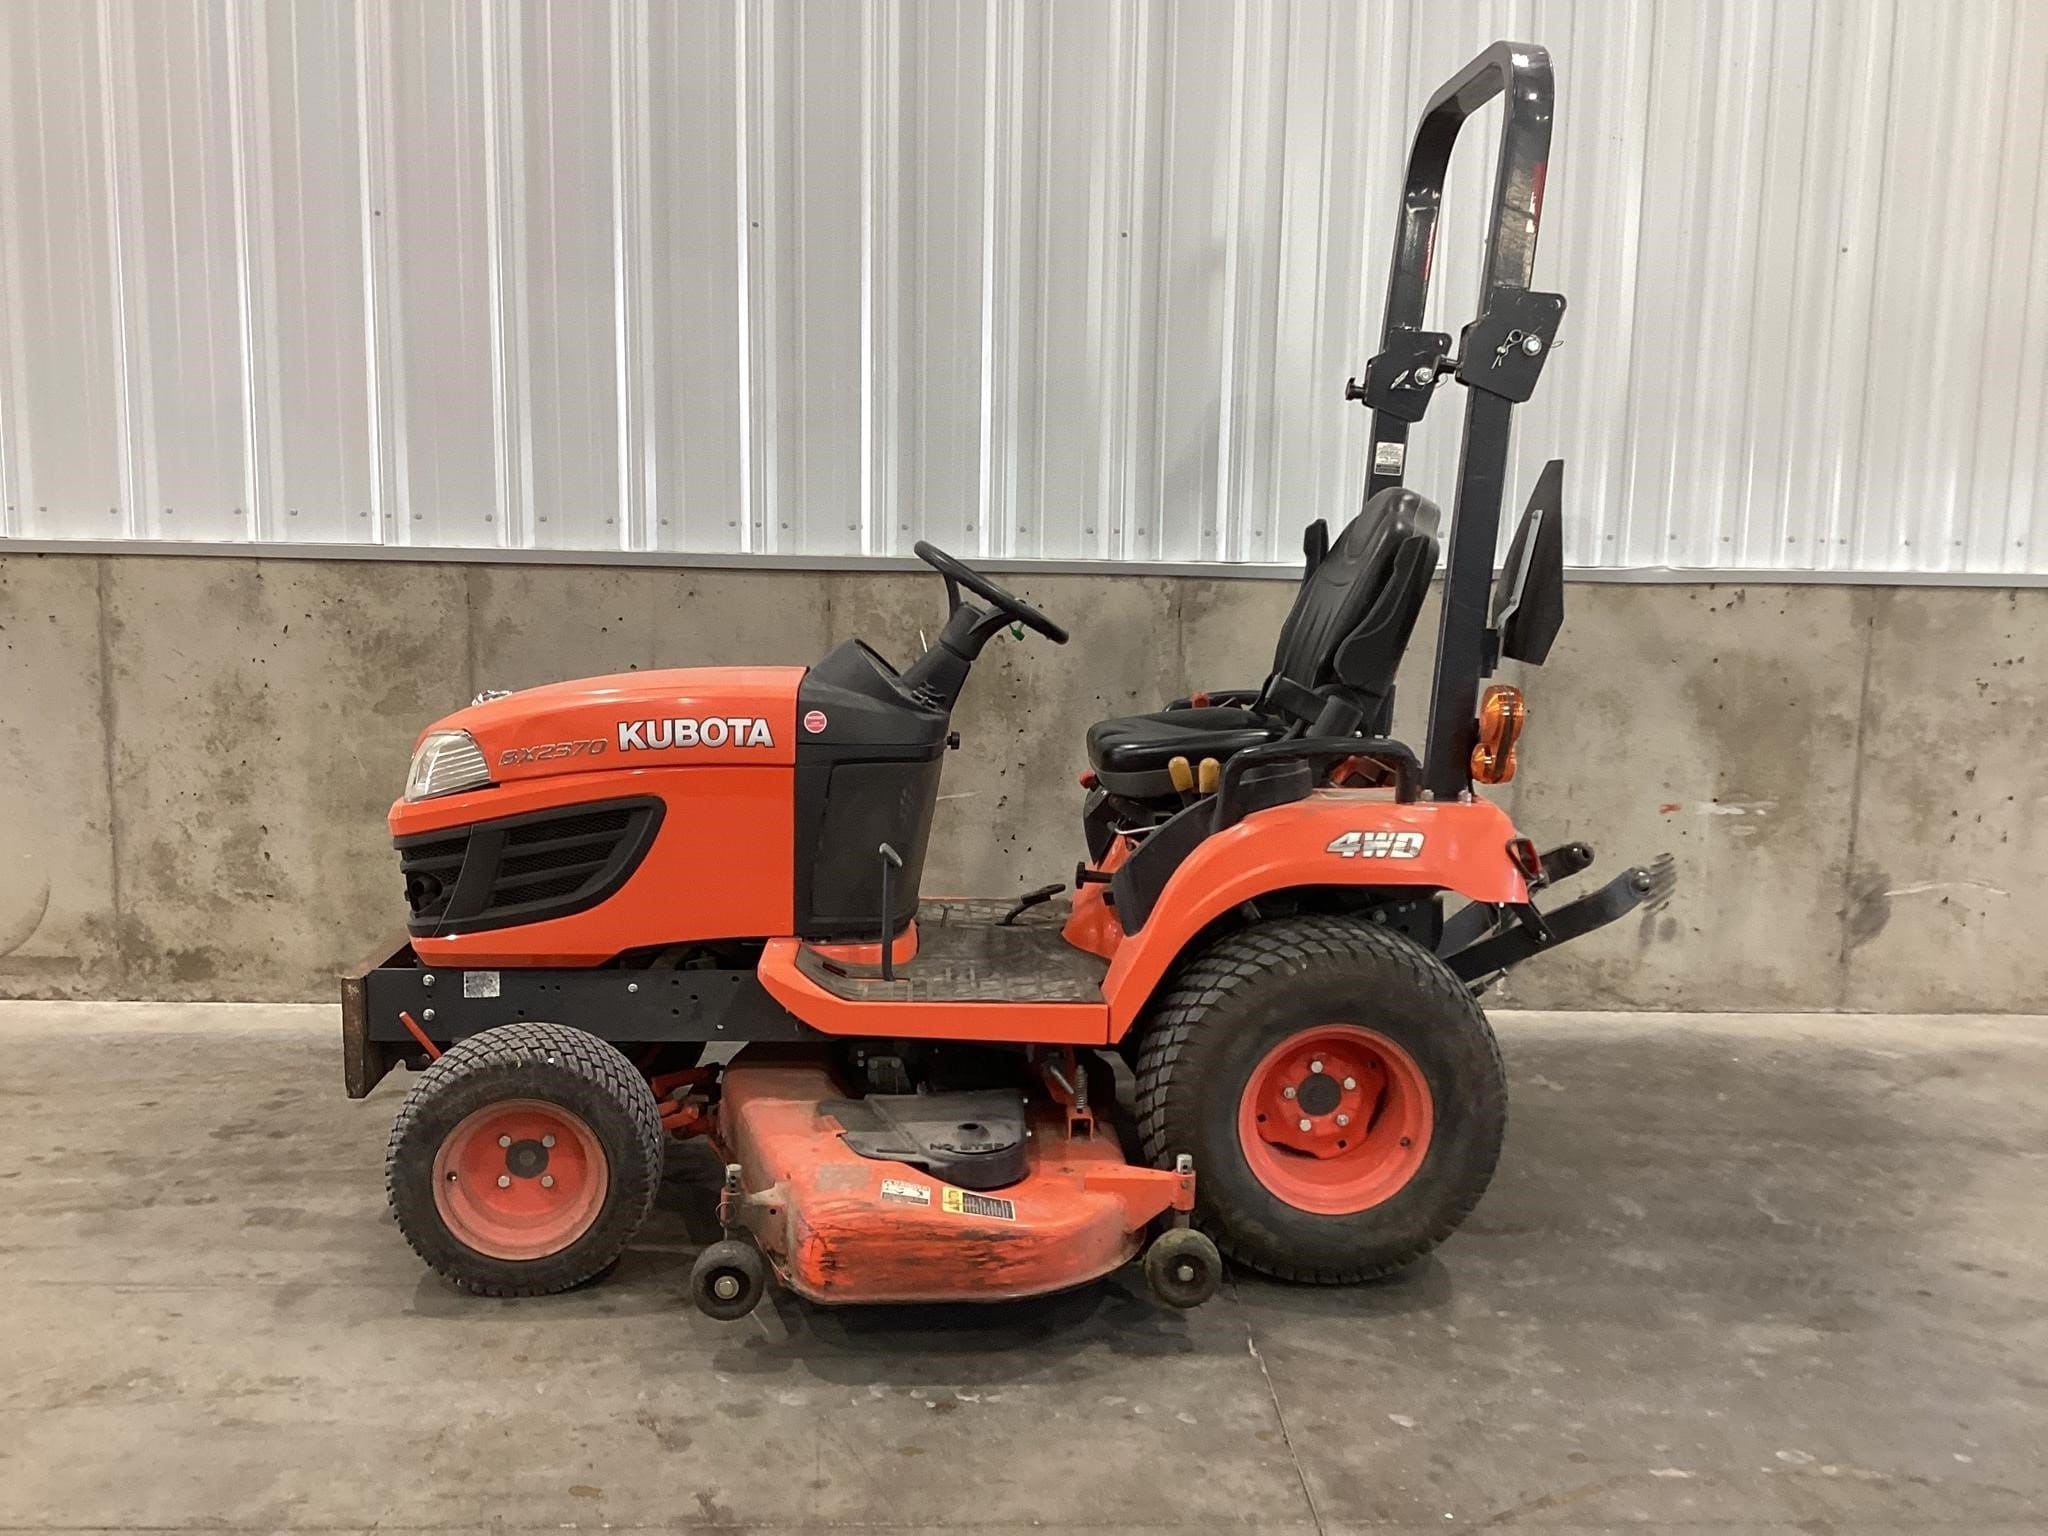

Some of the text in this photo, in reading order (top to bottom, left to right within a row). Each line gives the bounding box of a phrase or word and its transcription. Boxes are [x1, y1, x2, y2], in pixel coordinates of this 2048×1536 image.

[617, 716, 775, 751] KUBOTA
[498, 738, 608, 766] BX2370
[1326, 831, 1425, 858] 4WD
